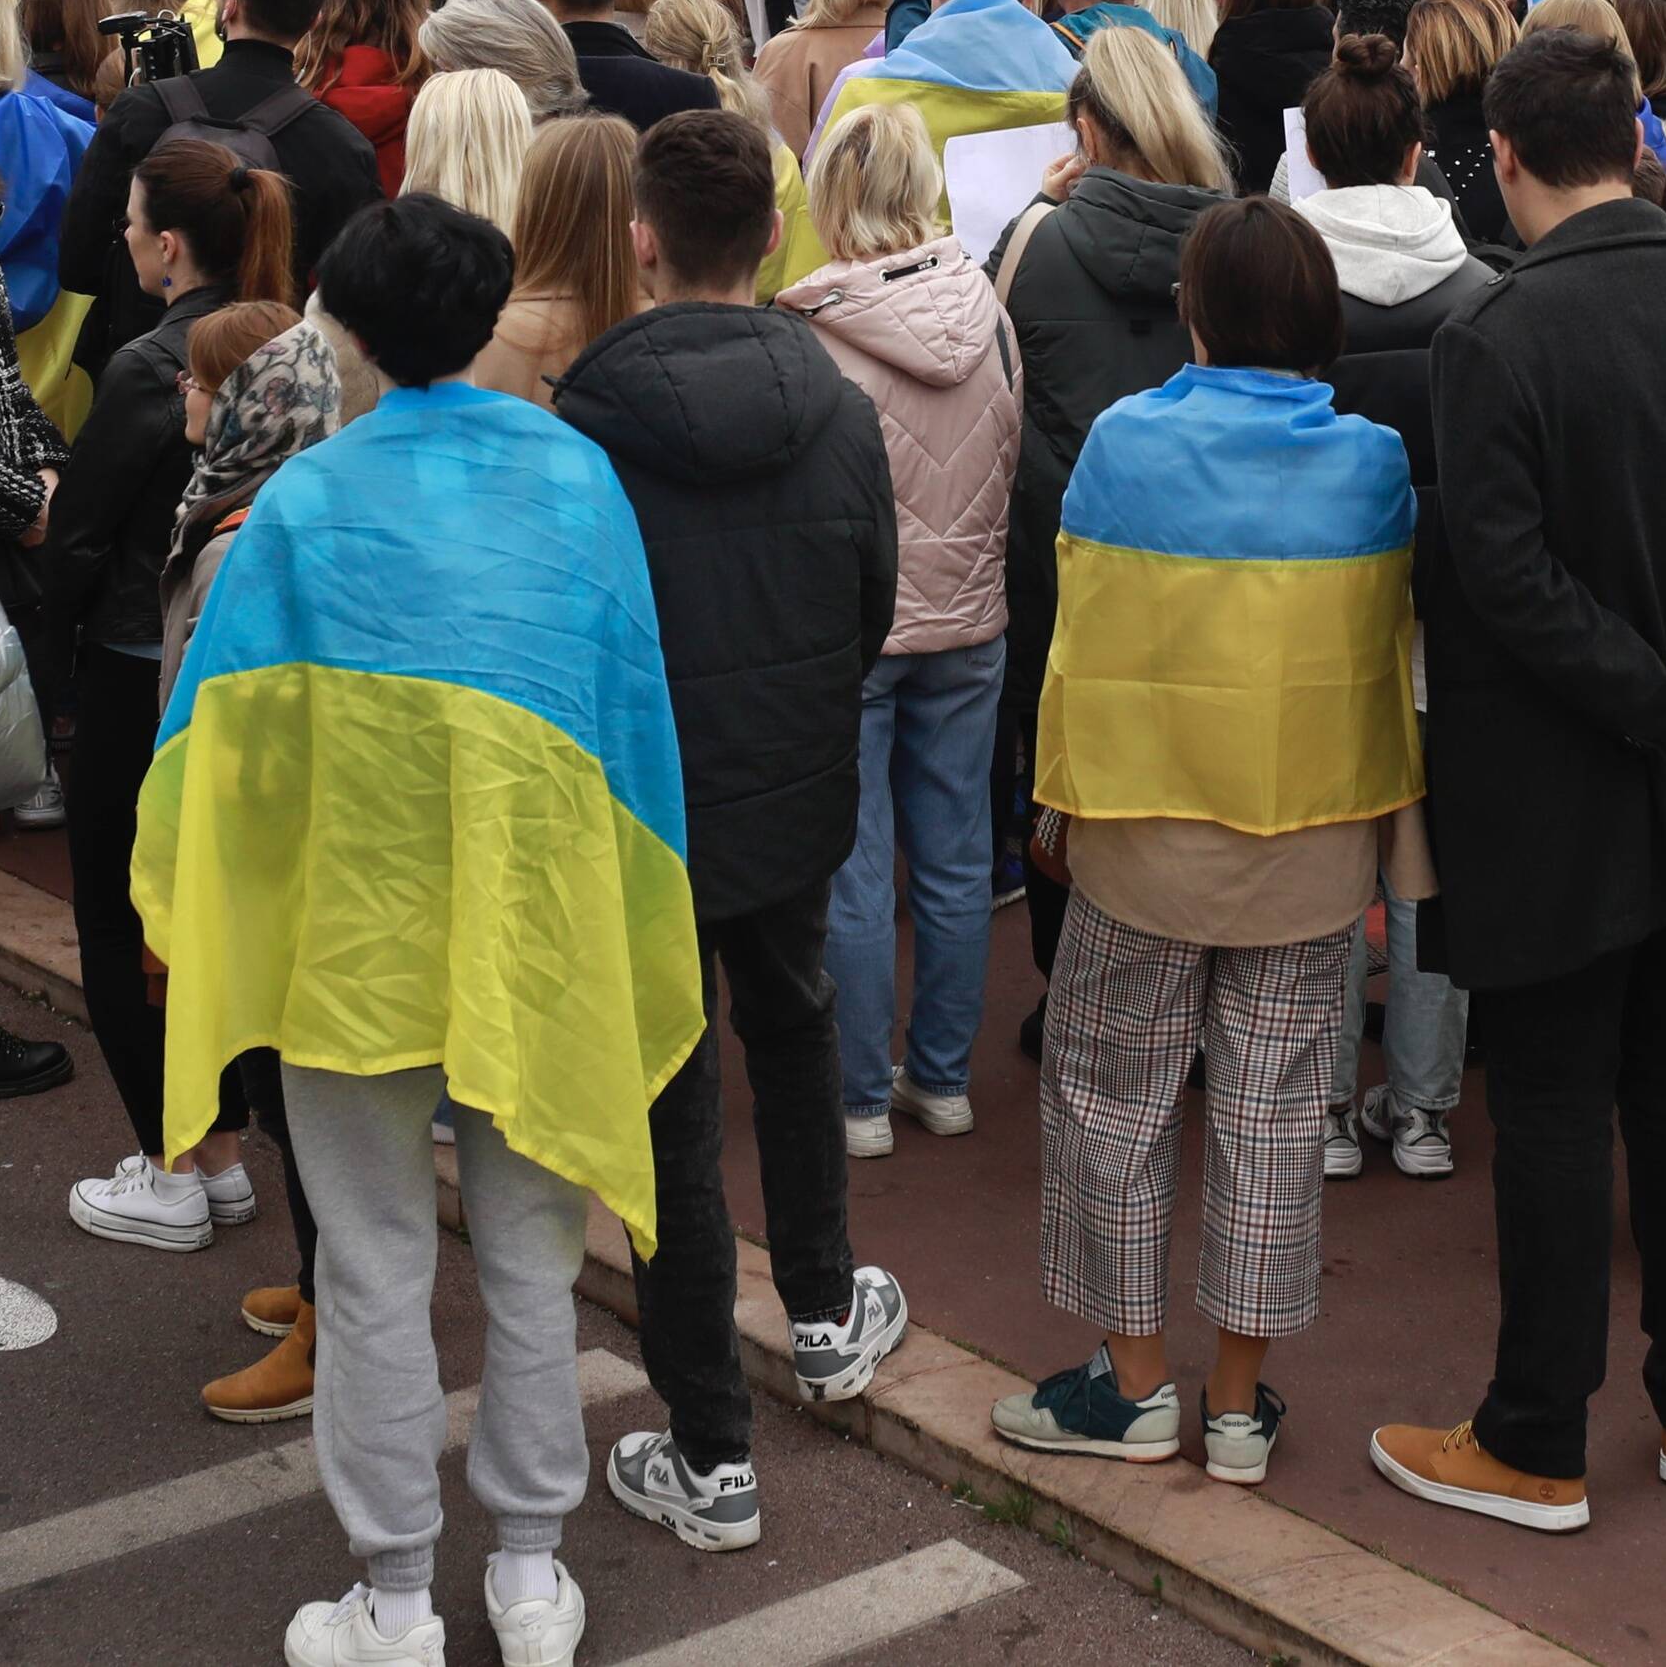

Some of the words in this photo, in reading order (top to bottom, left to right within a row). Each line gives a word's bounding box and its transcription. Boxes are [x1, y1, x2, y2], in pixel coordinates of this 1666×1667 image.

[795, 1332, 832, 1347] FILA
[1221, 1420, 1251, 1428] Reebok
[648, 1463, 670, 1486] FILA
[719, 1472, 755, 1492] FILA
[661, 1512, 677, 1530] FILA
